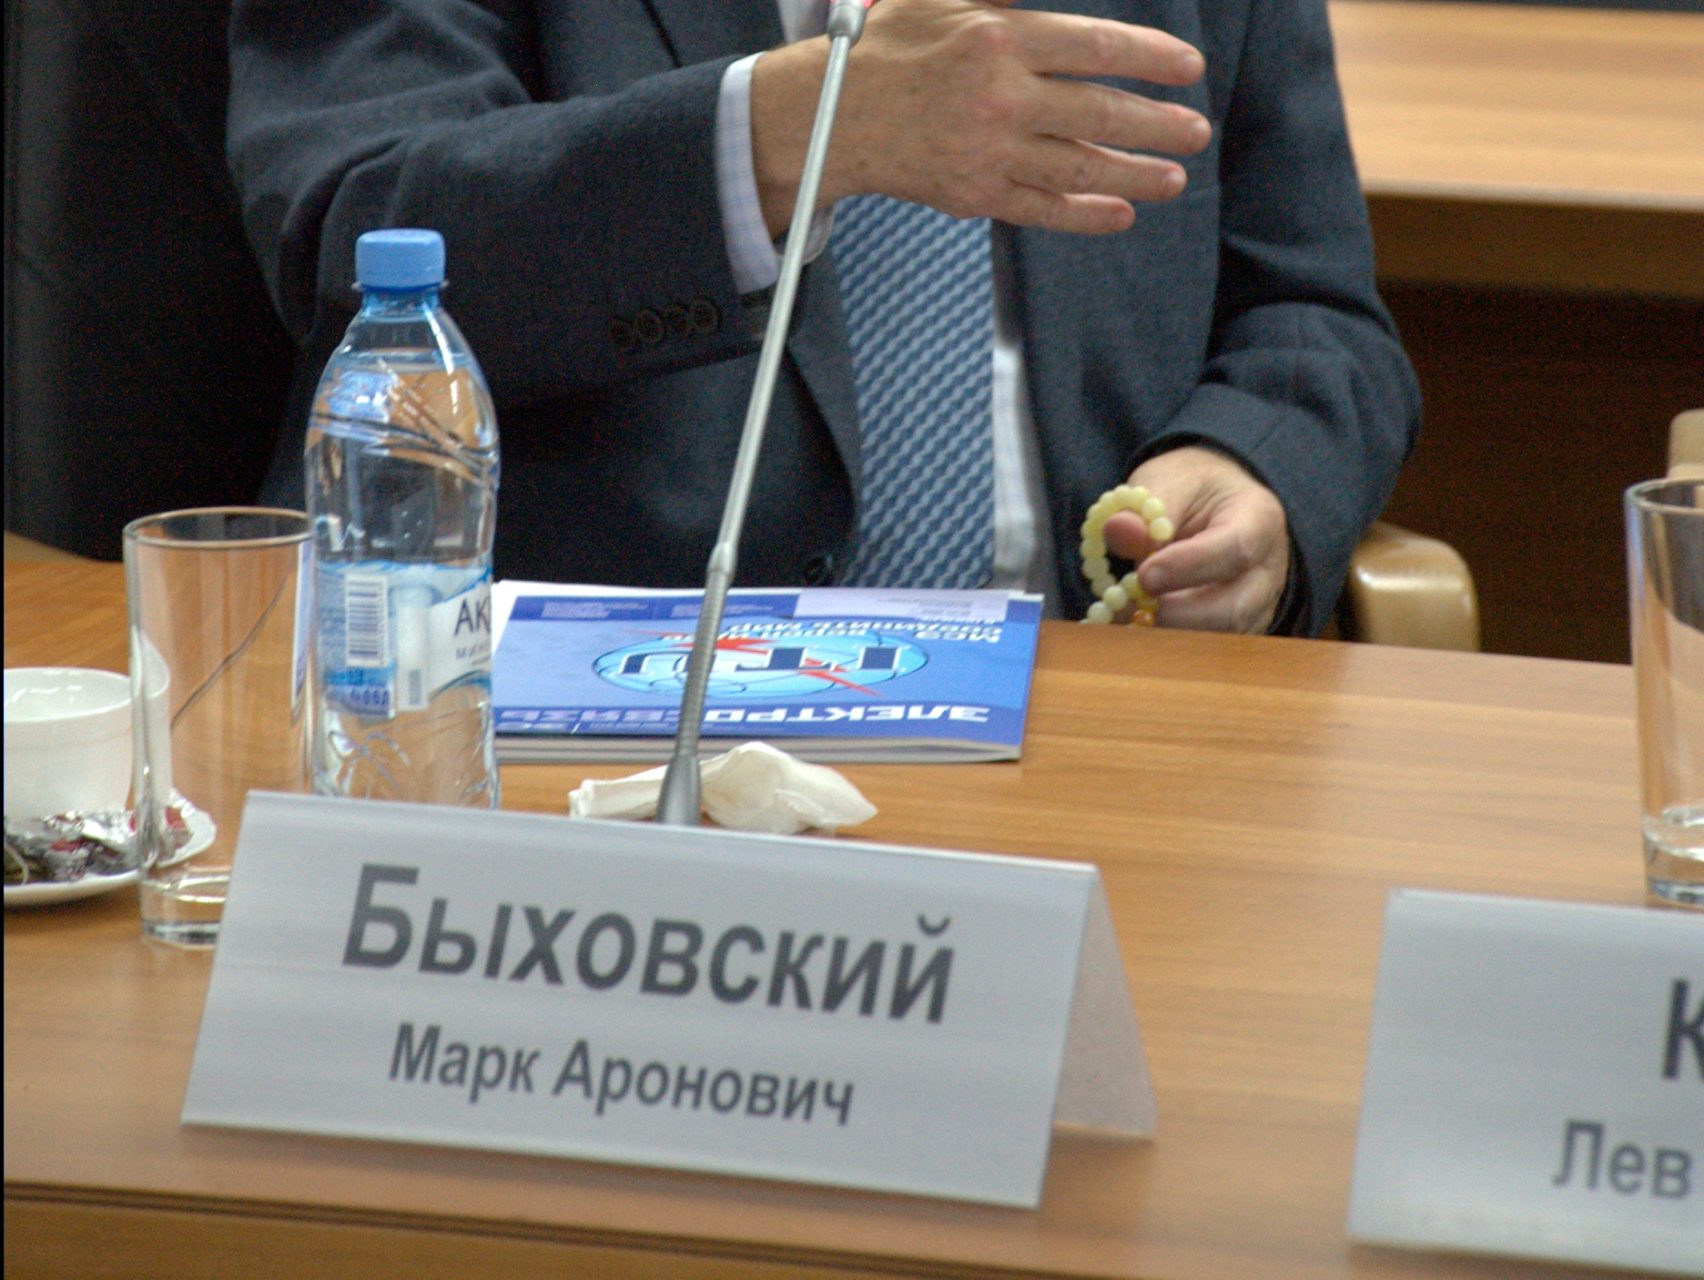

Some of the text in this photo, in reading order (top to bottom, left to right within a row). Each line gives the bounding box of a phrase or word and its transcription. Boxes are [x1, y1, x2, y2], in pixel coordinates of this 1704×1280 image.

[500, 704, 989, 723] ЭЛЕКТРОВЯЗЬ
[342, 863, 954, 1025] Быховский
[389, 1022, 855, 1125] Марк Аронович
[1552, 1119, 1693, 1198] Лев
